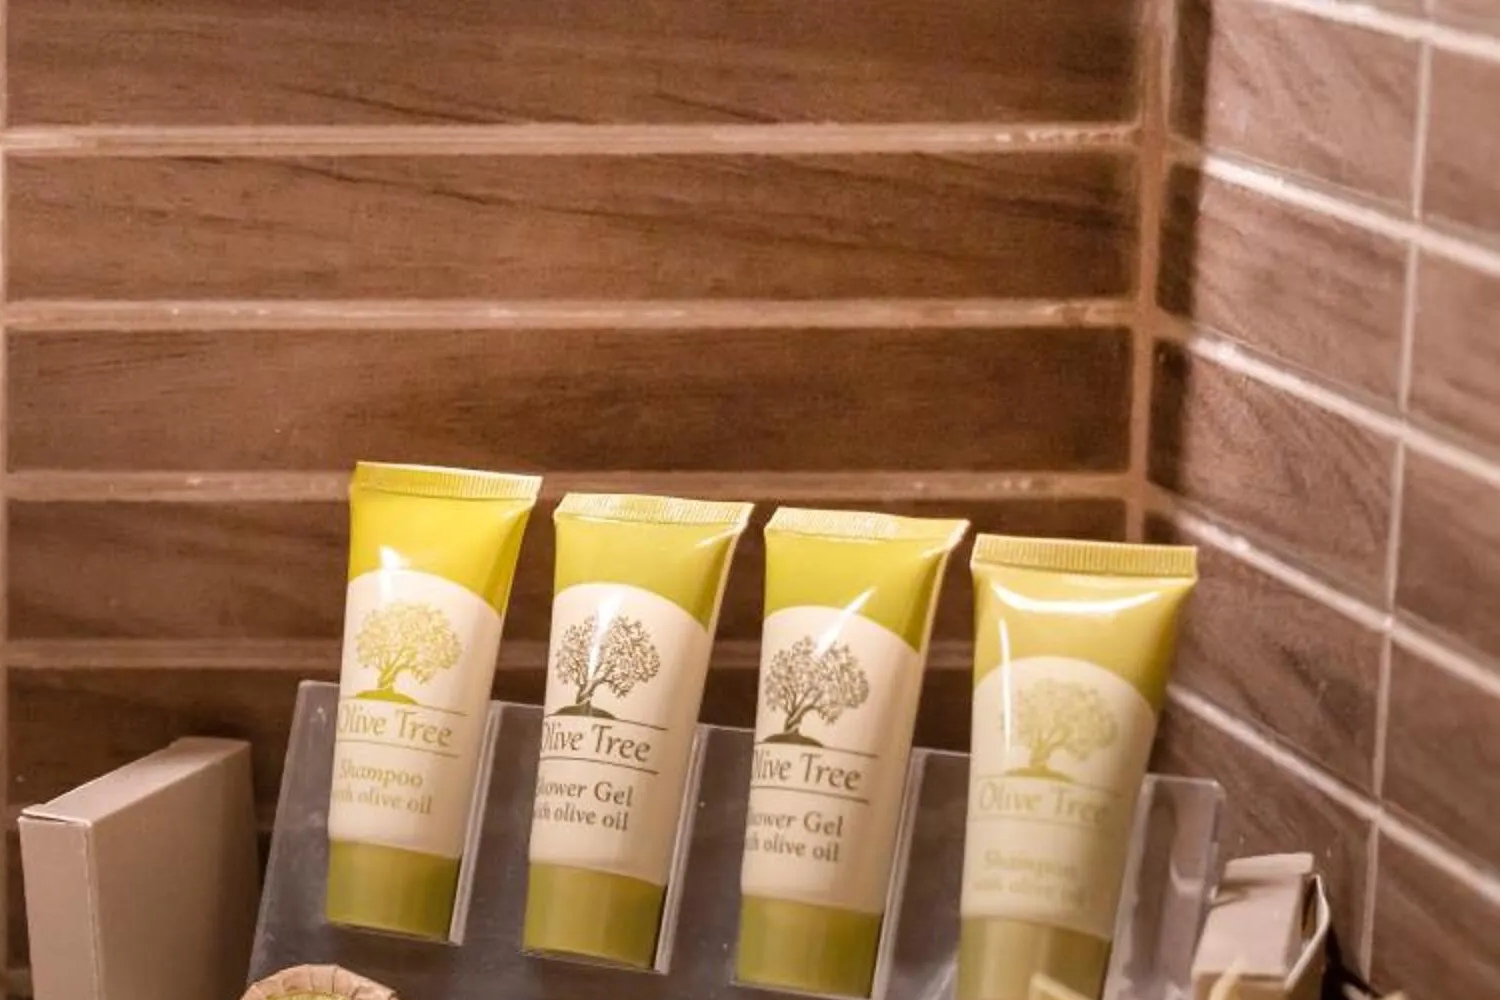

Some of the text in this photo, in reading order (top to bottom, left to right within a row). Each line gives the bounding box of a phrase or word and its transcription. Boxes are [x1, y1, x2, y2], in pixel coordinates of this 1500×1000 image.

[396, 709, 452, 747] Tree
[591, 724, 651, 762] Tree
[801, 753, 861, 791] Tree
[406, 795, 433, 815] oil
[594, 781, 633, 807] Gel
[979, 781, 1042, 812] Olive
[554, 802, 597, 825] olive
[602, 811, 629, 832] oil
[803, 811, 843, 837] Gel
[763, 833, 806, 857] olive
[812, 840, 839, 862] oil
